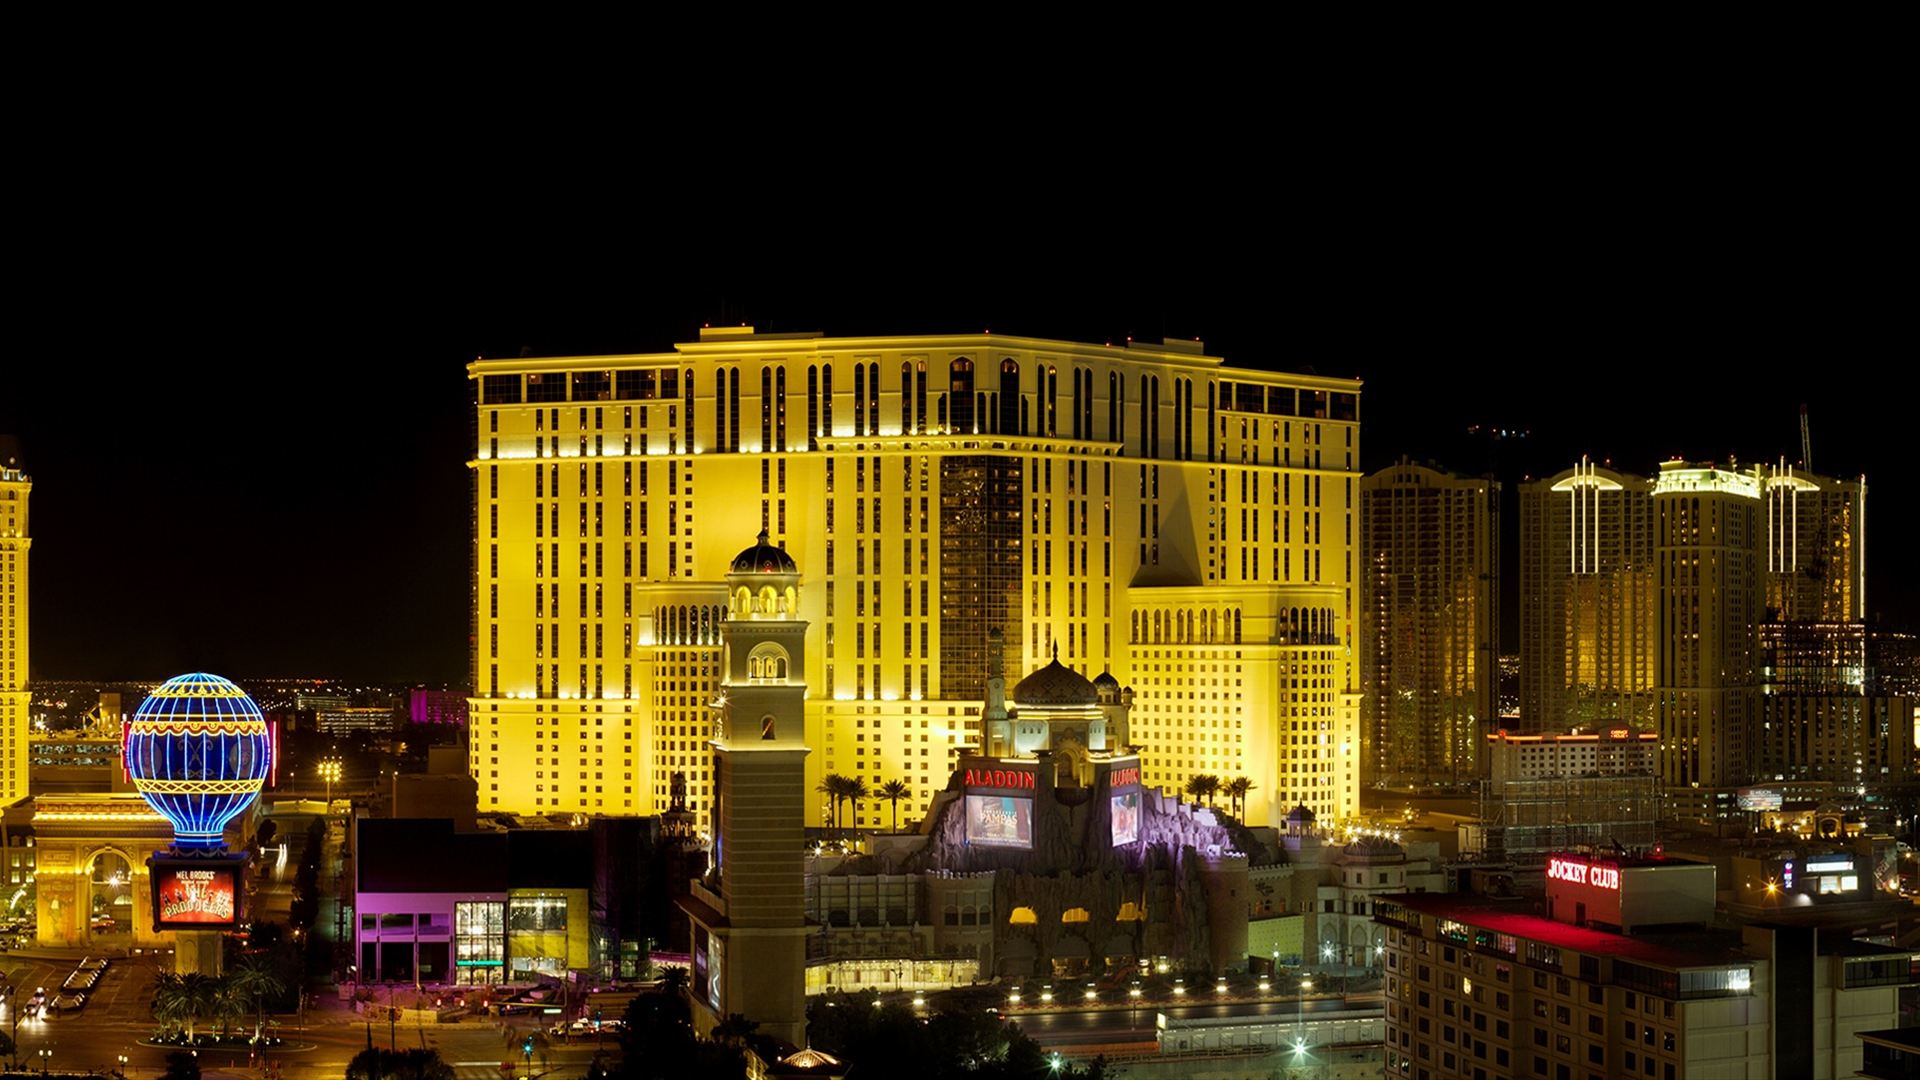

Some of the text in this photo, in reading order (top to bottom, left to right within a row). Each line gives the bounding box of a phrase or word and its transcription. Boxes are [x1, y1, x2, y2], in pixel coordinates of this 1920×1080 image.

[964, 769, 1035, 789] ALADDIN
[980, 812, 1018, 825] PAMPAS
[176, 871, 188, 880] MEL
[1547, 859, 1619, 890] JOCKEY CLUB
[165, 900, 229, 918] PRODUCERS
